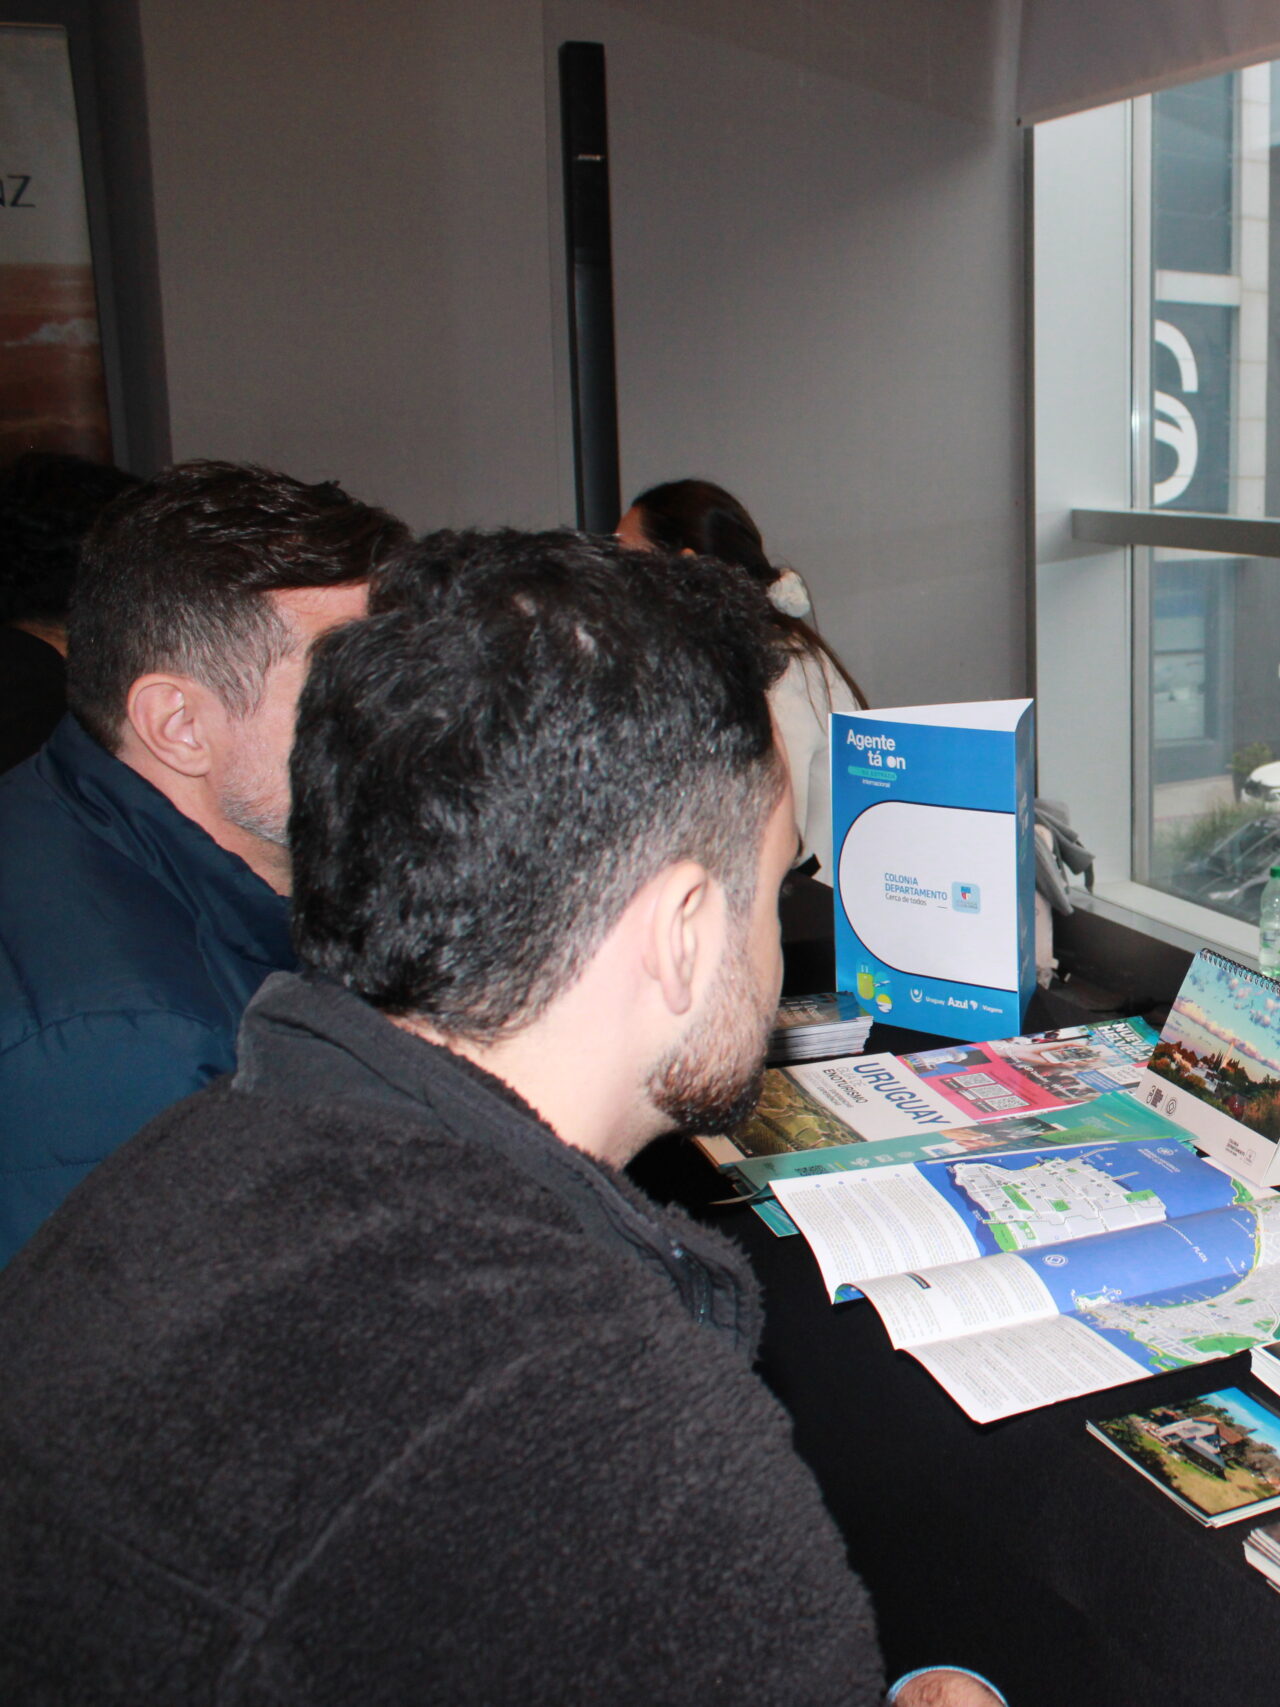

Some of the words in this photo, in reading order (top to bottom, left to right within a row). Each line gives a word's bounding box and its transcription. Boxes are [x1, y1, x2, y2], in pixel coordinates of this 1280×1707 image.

[846, 728, 897, 751] Agente
[867, 750, 883, 767] tá
[884, 872, 919, 887] COLONIA
[884, 883, 948, 901] DEPARTAMENTO
[885, 893, 901, 902] Cerca
[910, 897, 927, 906] todos
[947, 996, 969, 1010] Azul
[823, 1068, 869, 1103] ENOTURISMO
[852, 1062, 952, 1125] URUGUAY
